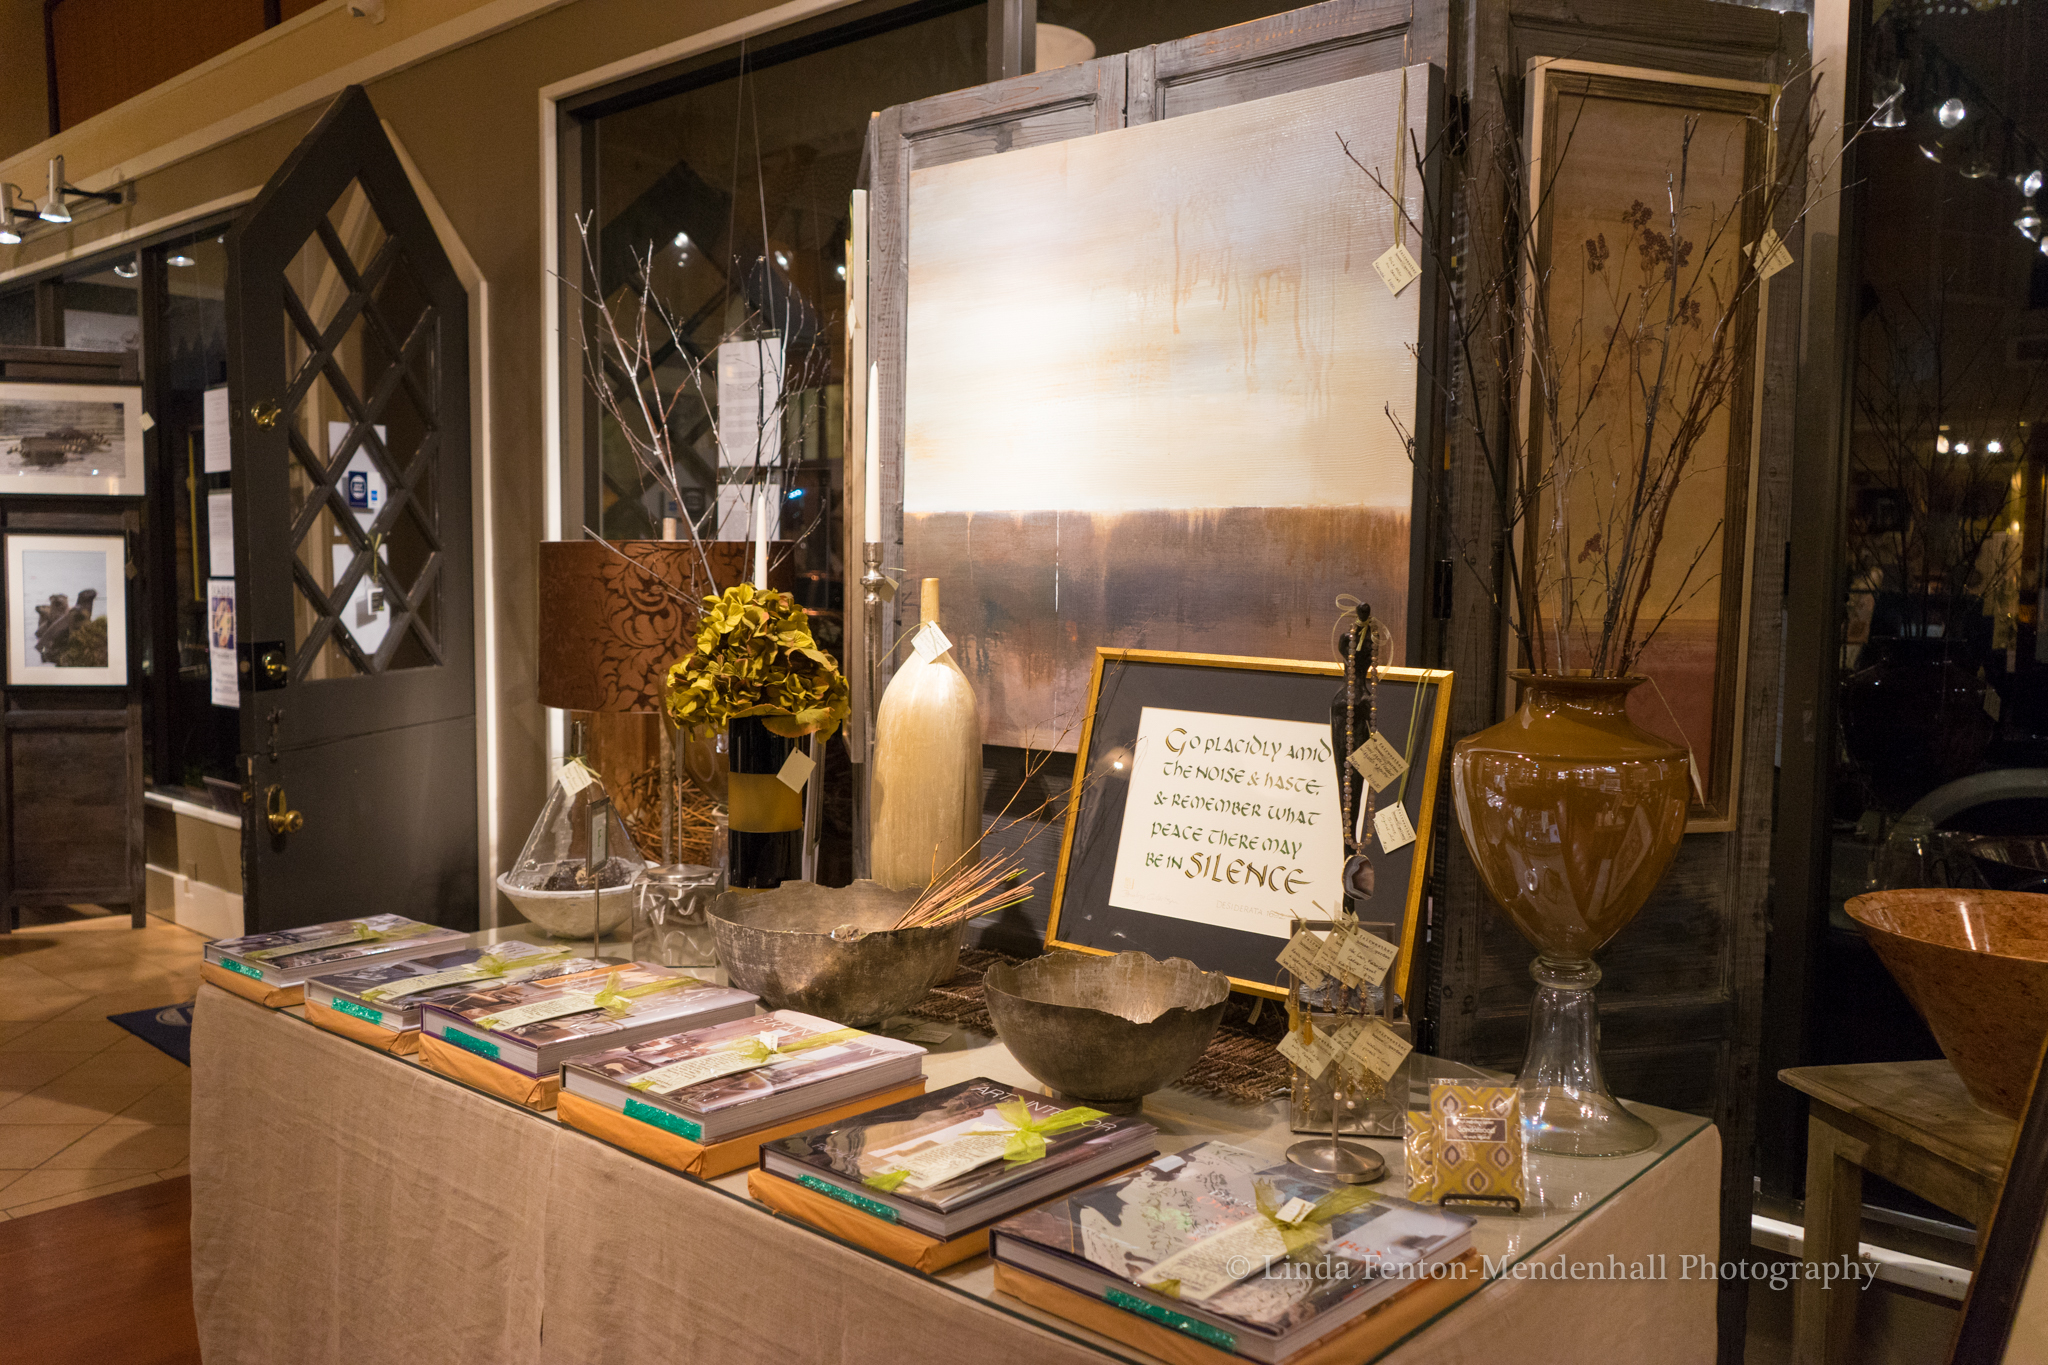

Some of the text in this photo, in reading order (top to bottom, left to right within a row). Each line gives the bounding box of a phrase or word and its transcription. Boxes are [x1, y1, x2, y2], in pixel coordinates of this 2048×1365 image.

[1196, 766, 1245, 783] NOISE
[1247, 771, 1260, 786] &
[1154, 791, 1168, 805] &
[1171, 793, 1261, 816] REMEMBER
[1151, 821, 1302, 860] PEACE THERE MAY
[1145, 852, 1315, 895] BE IN SILENCE
[971, 1086, 1117, 1132] ART INTEOR
